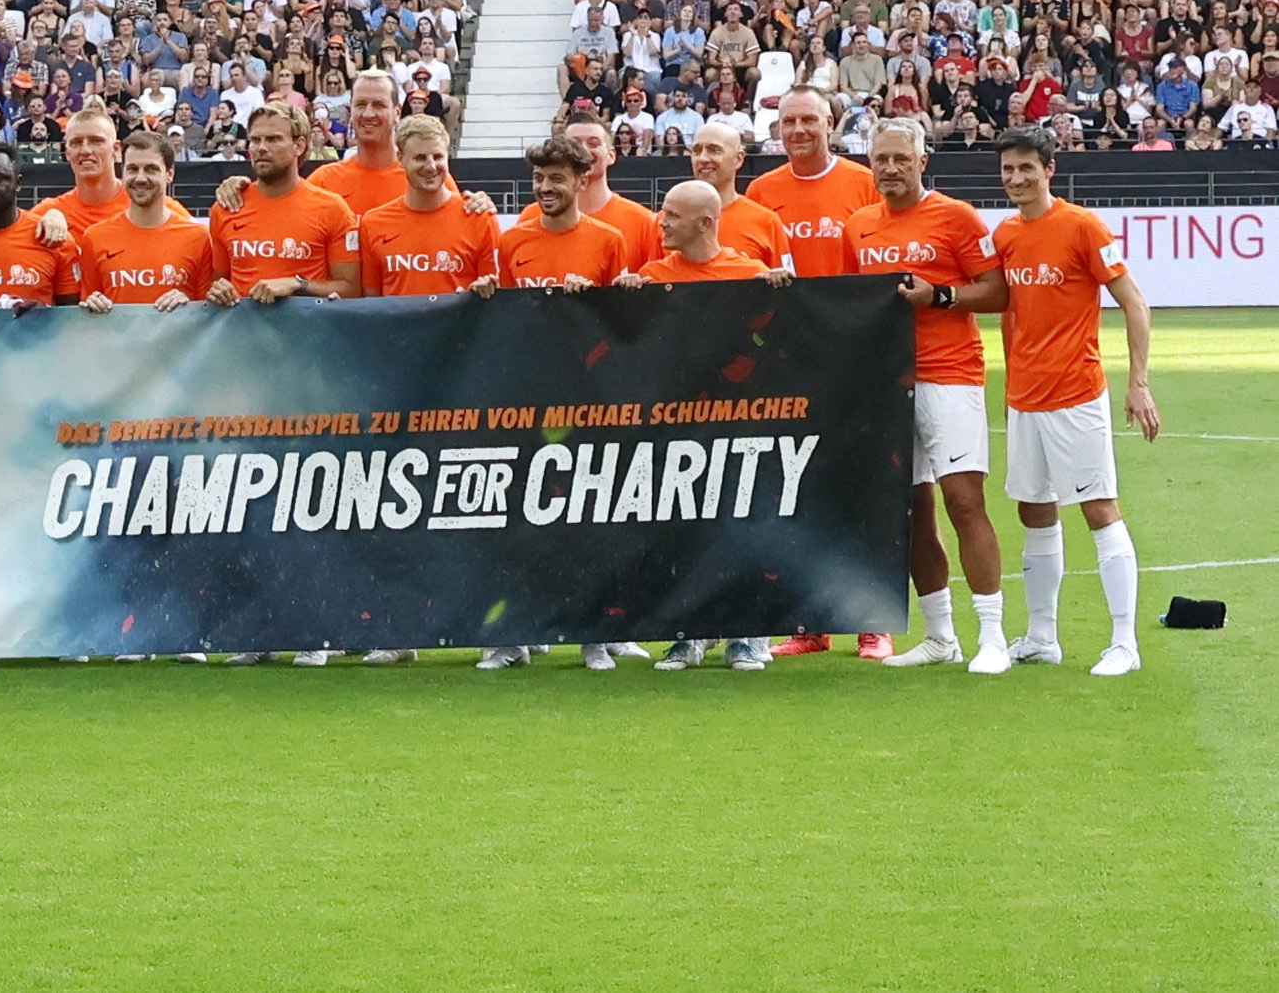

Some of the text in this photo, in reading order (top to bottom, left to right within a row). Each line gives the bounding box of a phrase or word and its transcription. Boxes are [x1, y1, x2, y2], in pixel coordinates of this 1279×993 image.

[784, 221, 813, 239] NG
[231, 240, 276, 258] ING
[859, 247, 901, 266] ING
[385, 253, 430, 272] ING
[110, 269, 156, 288] ING
[56, 397, 810, 445] DAS BENEFIZ-FUSSBALLSPIEL ZU EHREN VON MICHAEL SCHUMACHER
[43, 434, 821, 539] CHAMPIONS FOR CHARITY
